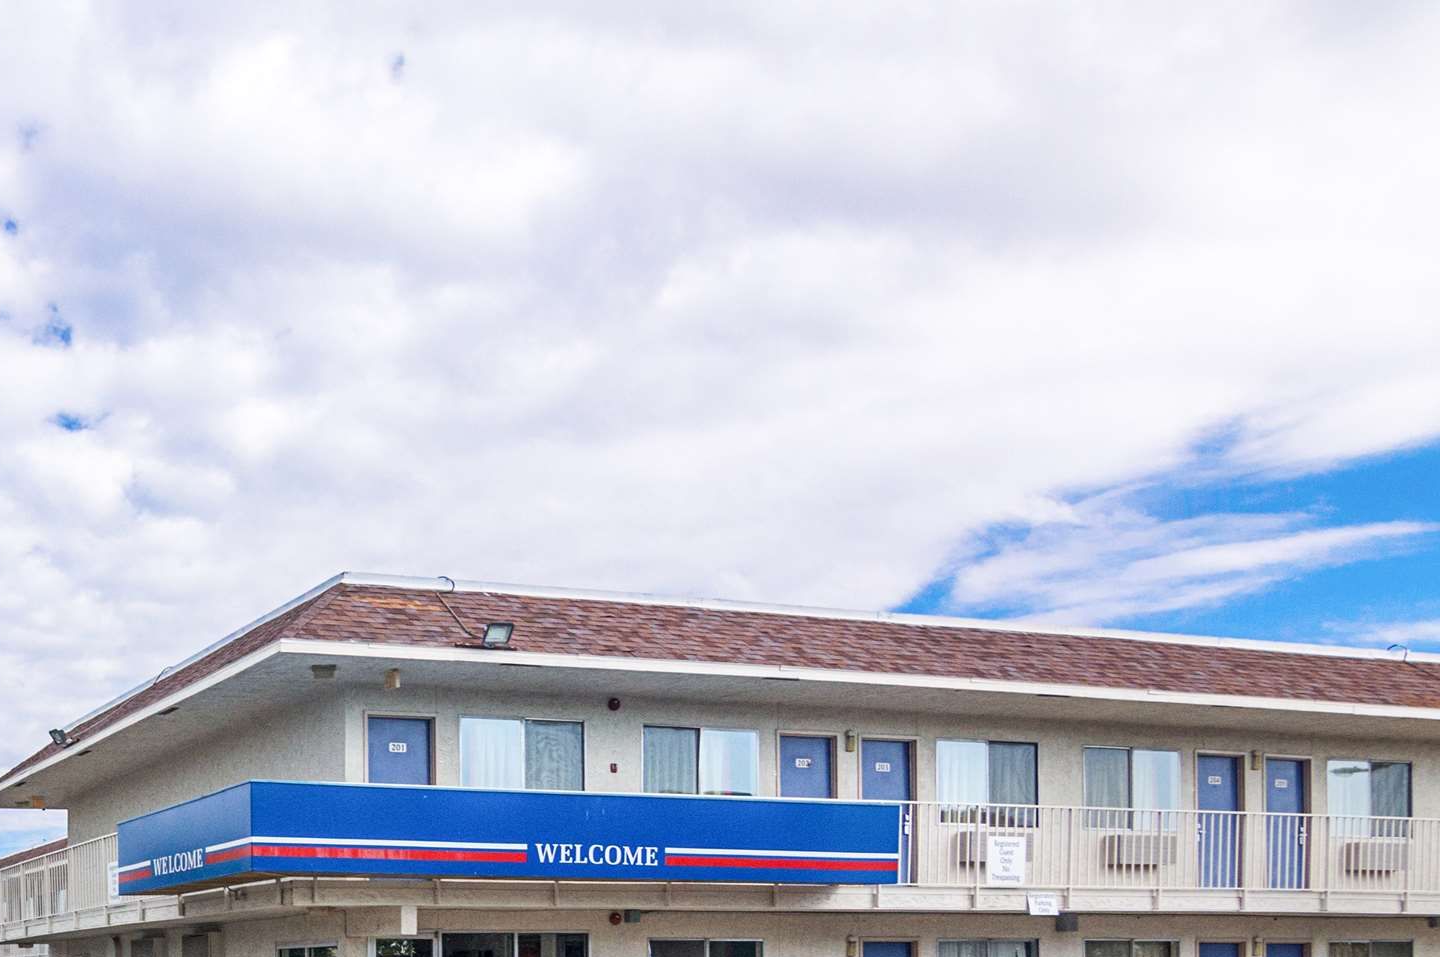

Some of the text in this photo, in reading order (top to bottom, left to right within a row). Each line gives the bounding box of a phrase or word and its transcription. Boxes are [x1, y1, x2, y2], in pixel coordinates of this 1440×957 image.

[391, 743, 405, 752] 201
[153, 848, 204, 877] WELCOME
[535, 843, 659, 867] WELCOME
